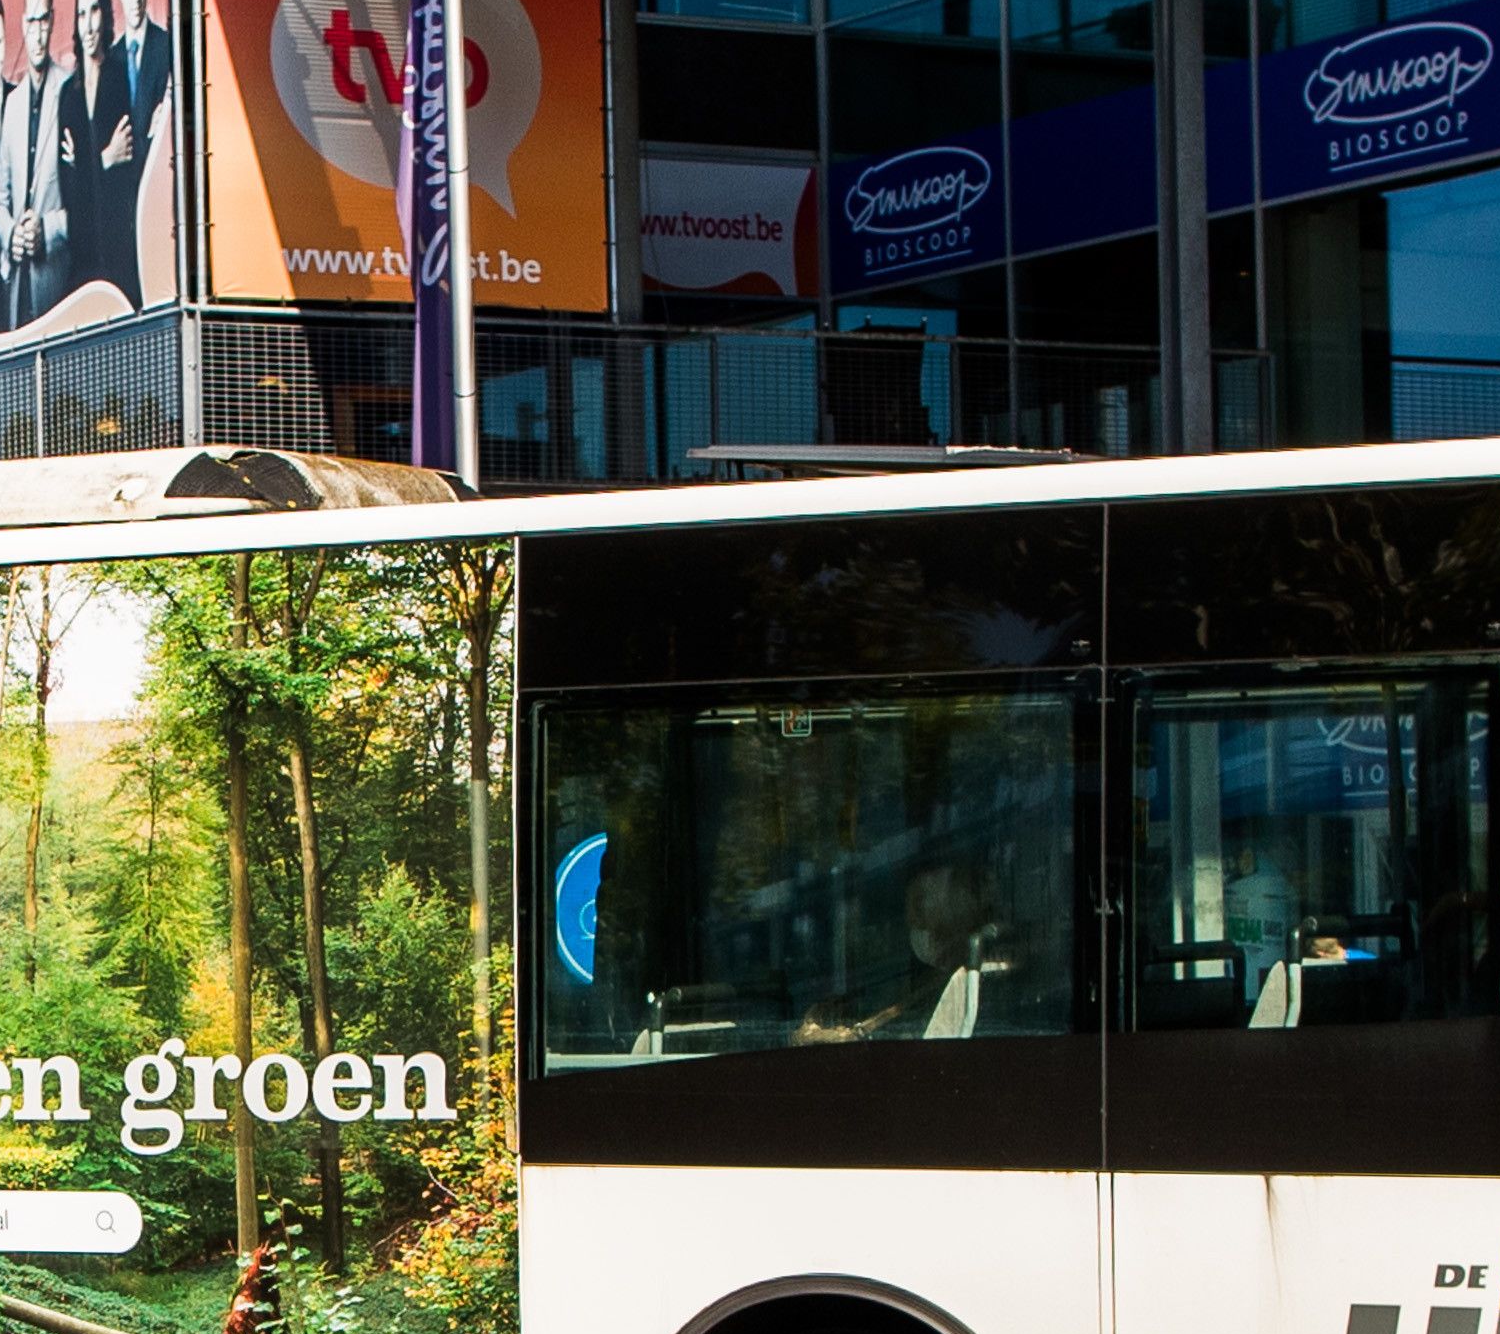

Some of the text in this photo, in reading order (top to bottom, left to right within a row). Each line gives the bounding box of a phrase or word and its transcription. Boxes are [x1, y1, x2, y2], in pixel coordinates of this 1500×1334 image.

[1330, 112, 1468, 160] BIOSCOOP
[865, 226, 971, 266] BIOSCOOP
[120, 1037, 458, 1156] groen
[1434, 1264, 1489, 1289] DE
